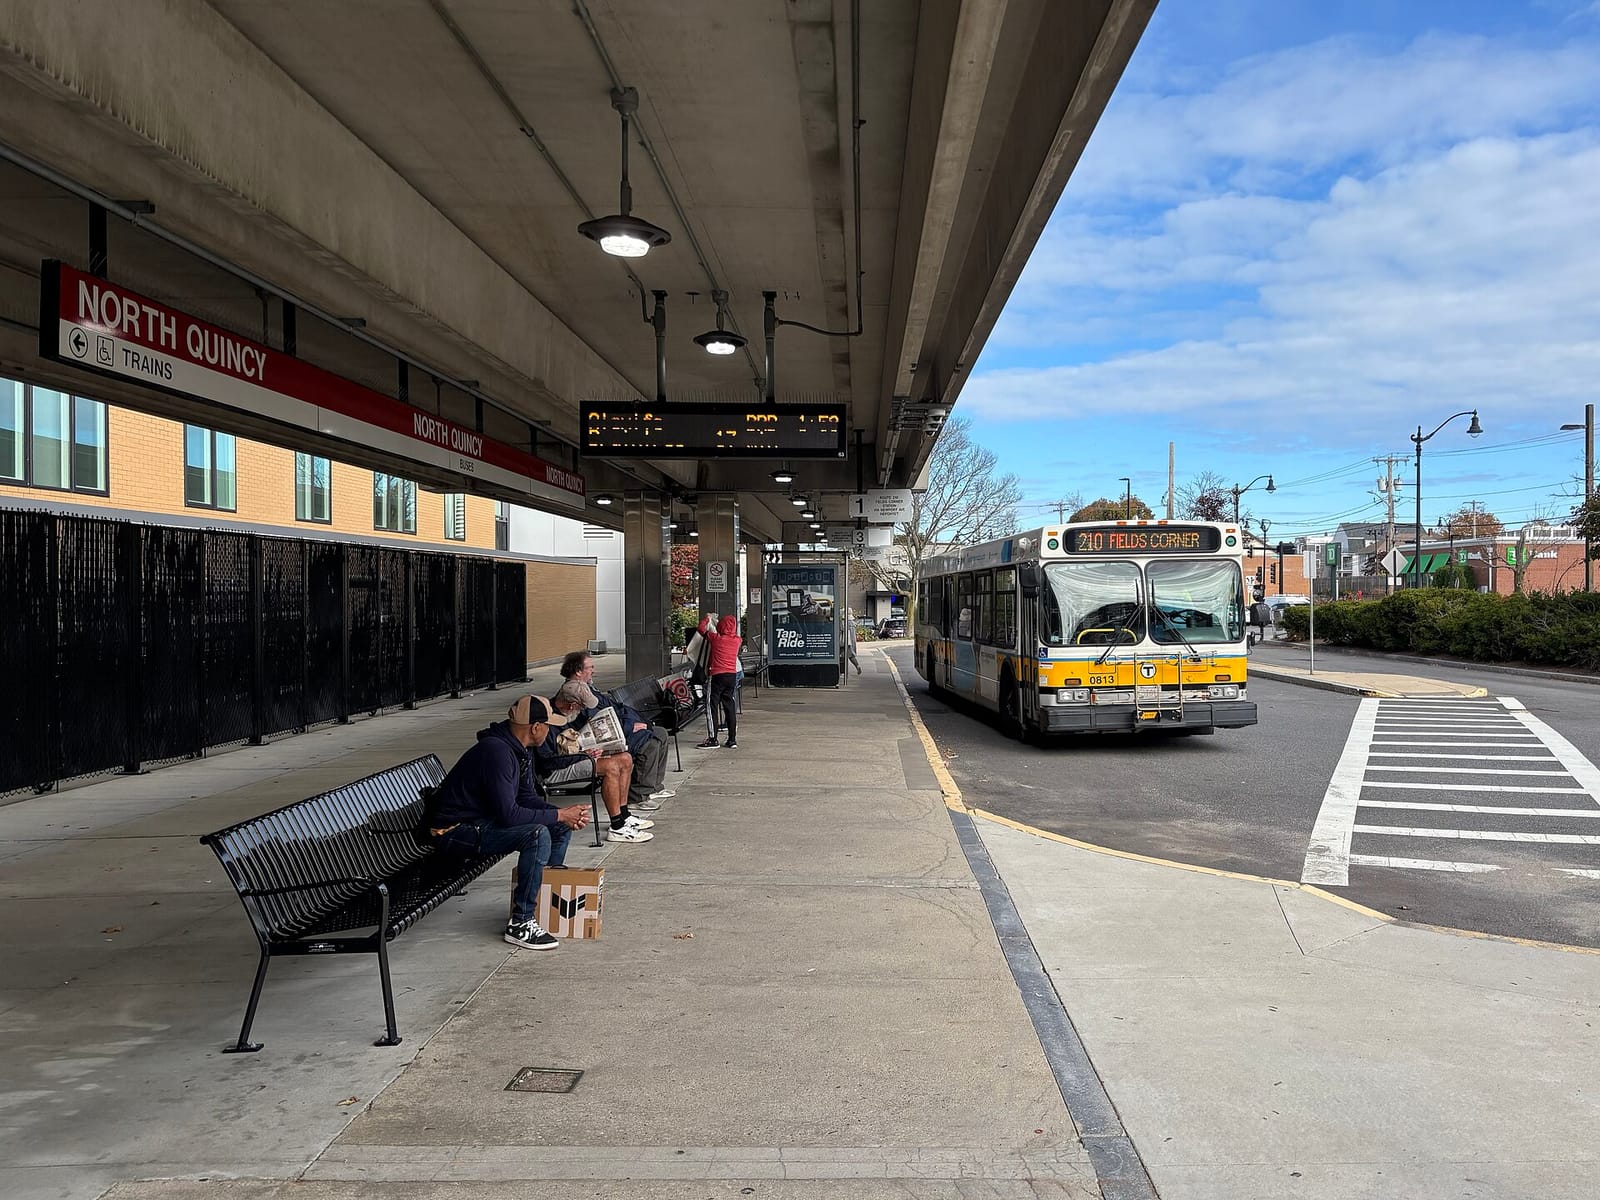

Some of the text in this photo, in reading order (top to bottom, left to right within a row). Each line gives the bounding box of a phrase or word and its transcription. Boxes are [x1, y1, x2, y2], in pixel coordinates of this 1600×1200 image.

[78, 279, 267, 381] NORTH QUINCY
[122, 347, 173, 380] TRAINS
[413, 412, 483, 457] NORTH QUINCY
[460, 458, 474, 473] BUSES
[546, 464, 583, 493] NORTH QUINCY
[855, 498, 863, 514] 1
[856, 532, 864, 542] 3
[1078, 532, 1200, 551] 210 FIELDS CORNER
[857, 548, 863, 557] 2
[776, 628, 796, 642] Tap
[778, 637, 805, 648] Ride
[1089, 675, 1115, 685] 0813
